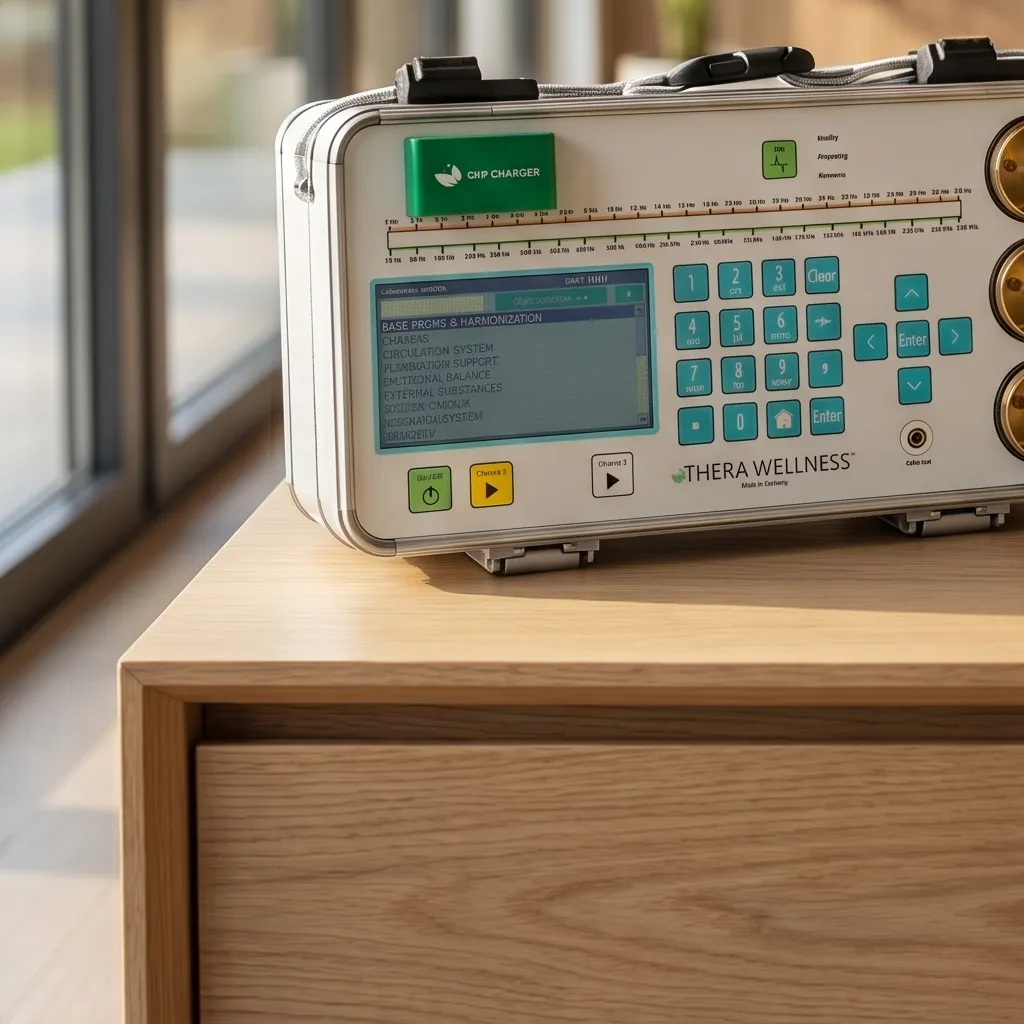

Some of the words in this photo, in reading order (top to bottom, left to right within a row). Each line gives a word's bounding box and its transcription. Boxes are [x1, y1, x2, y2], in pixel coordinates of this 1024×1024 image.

[490, 167, 541, 179] CHARGER
[732, 267, 740, 284] 2
[775, 265, 783, 282] 3
[688, 274, 695, 292] 1
[382, 319, 409, 332] BASE
[411, 316, 447, 330] PRGMS
[450, 317, 458, 327] &
[460, 312, 543, 327] HARMONIZATION
[688, 318, 697, 335] 4
[733, 314, 741, 332] 5
[776, 312, 785, 329] 6
[899, 332, 928, 348] Enter
[382, 346, 450, 361] CIRCULATION
[453, 343, 494, 355] SYSTEM
[690, 365, 698, 382] 7
[735, 362, 743, 378] 8
[778, 358, 786, 375] 9
[446, 370, 491, 383] BALANCE
[437, 382, 503, 396] SUBSTANCES
[736, 413, 745, 431] 0
[813, 409, 843, 425] Enter
[684, 461, 749, 483] THERA
[753, 452, 851, 477] WELLNESS
